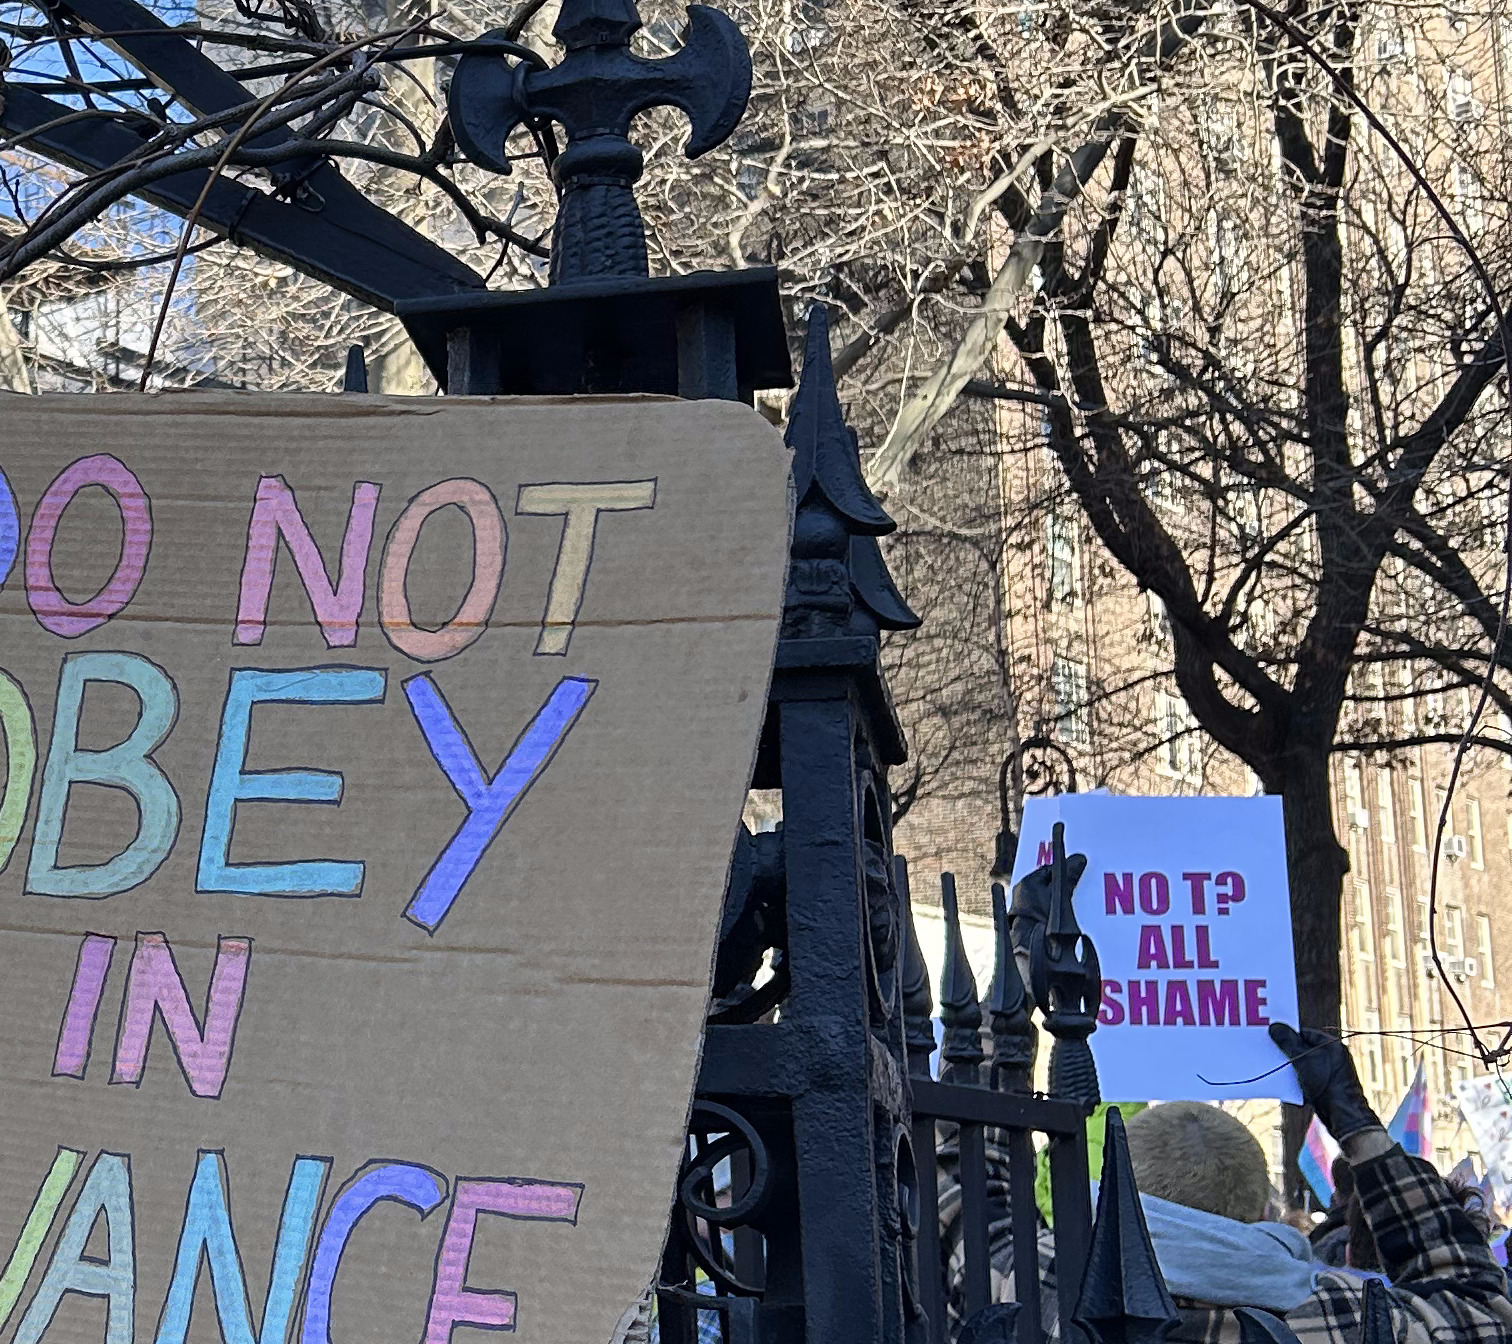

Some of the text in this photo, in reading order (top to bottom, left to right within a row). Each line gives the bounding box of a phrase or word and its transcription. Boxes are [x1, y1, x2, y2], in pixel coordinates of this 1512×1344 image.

[231, 473, 657, 664] NOT
[1104, 871, 1246, 916] NO T?
[1137, 925, 1219, 969] ALL
[51, 929, 256, 1100] IN
[1097, 979, 1271, 1027] SHAME
